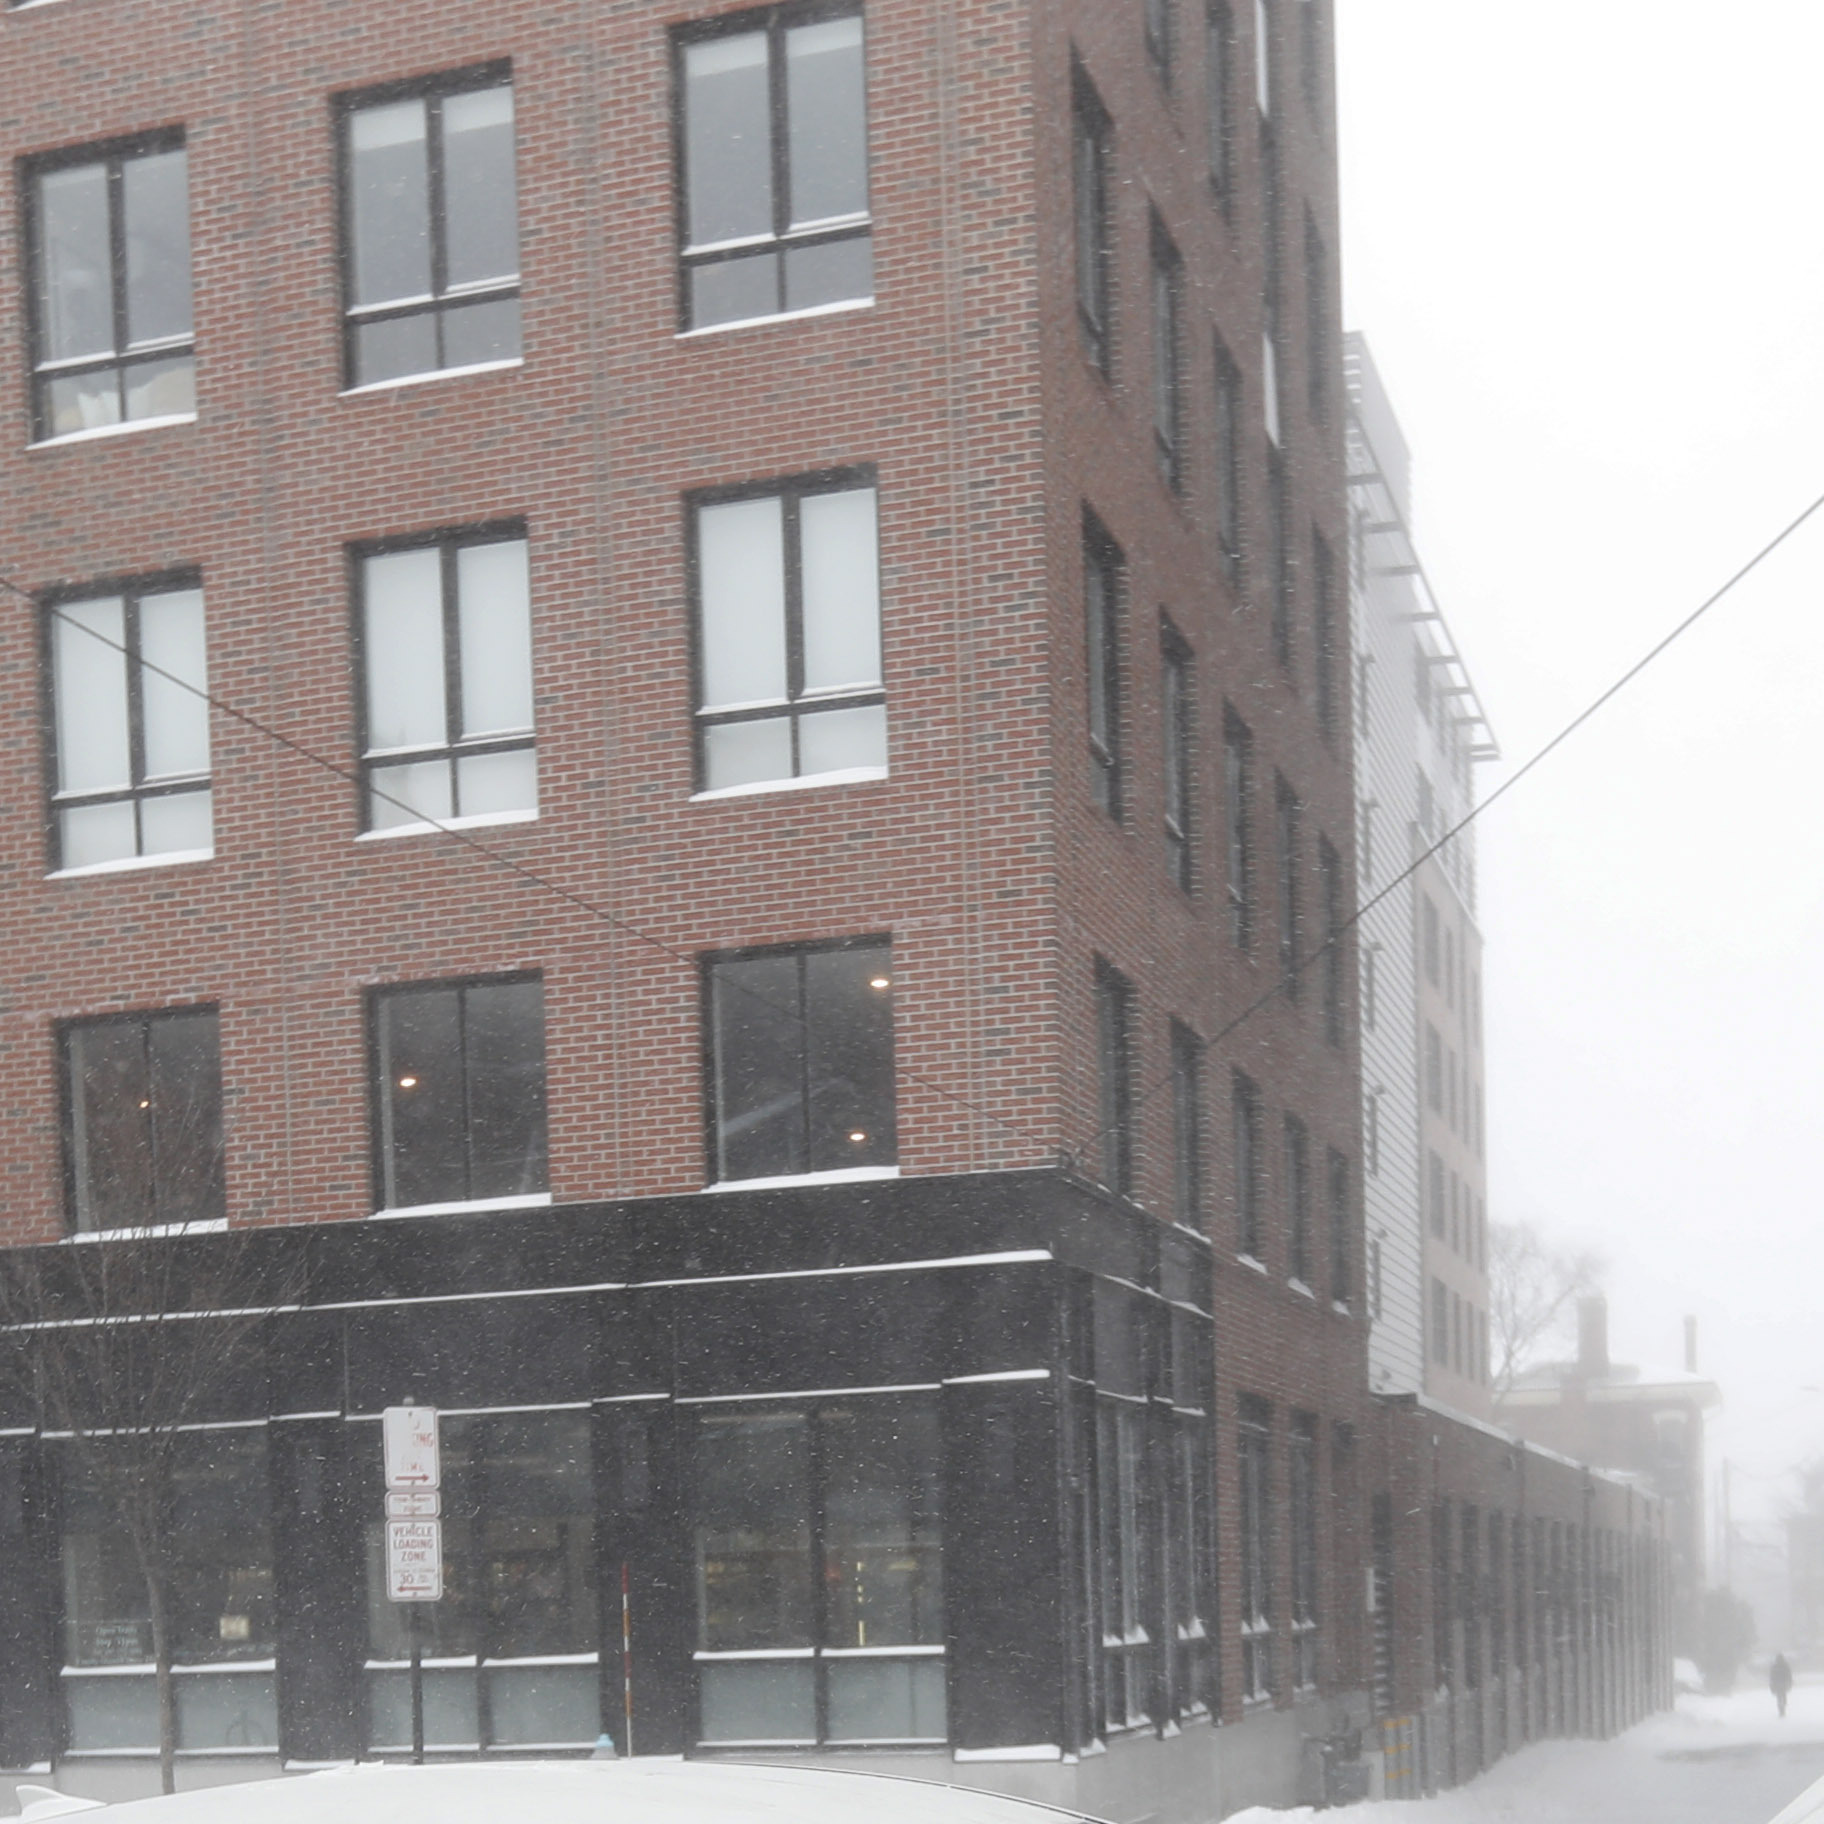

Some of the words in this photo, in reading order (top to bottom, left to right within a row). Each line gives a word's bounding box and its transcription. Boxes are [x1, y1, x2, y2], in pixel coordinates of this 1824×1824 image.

[393, 1527, 433, 1537] VEHICLE
[393, 1538, 434, 1550] LOADING
[401, 1551, 427, 1562] ZONE
